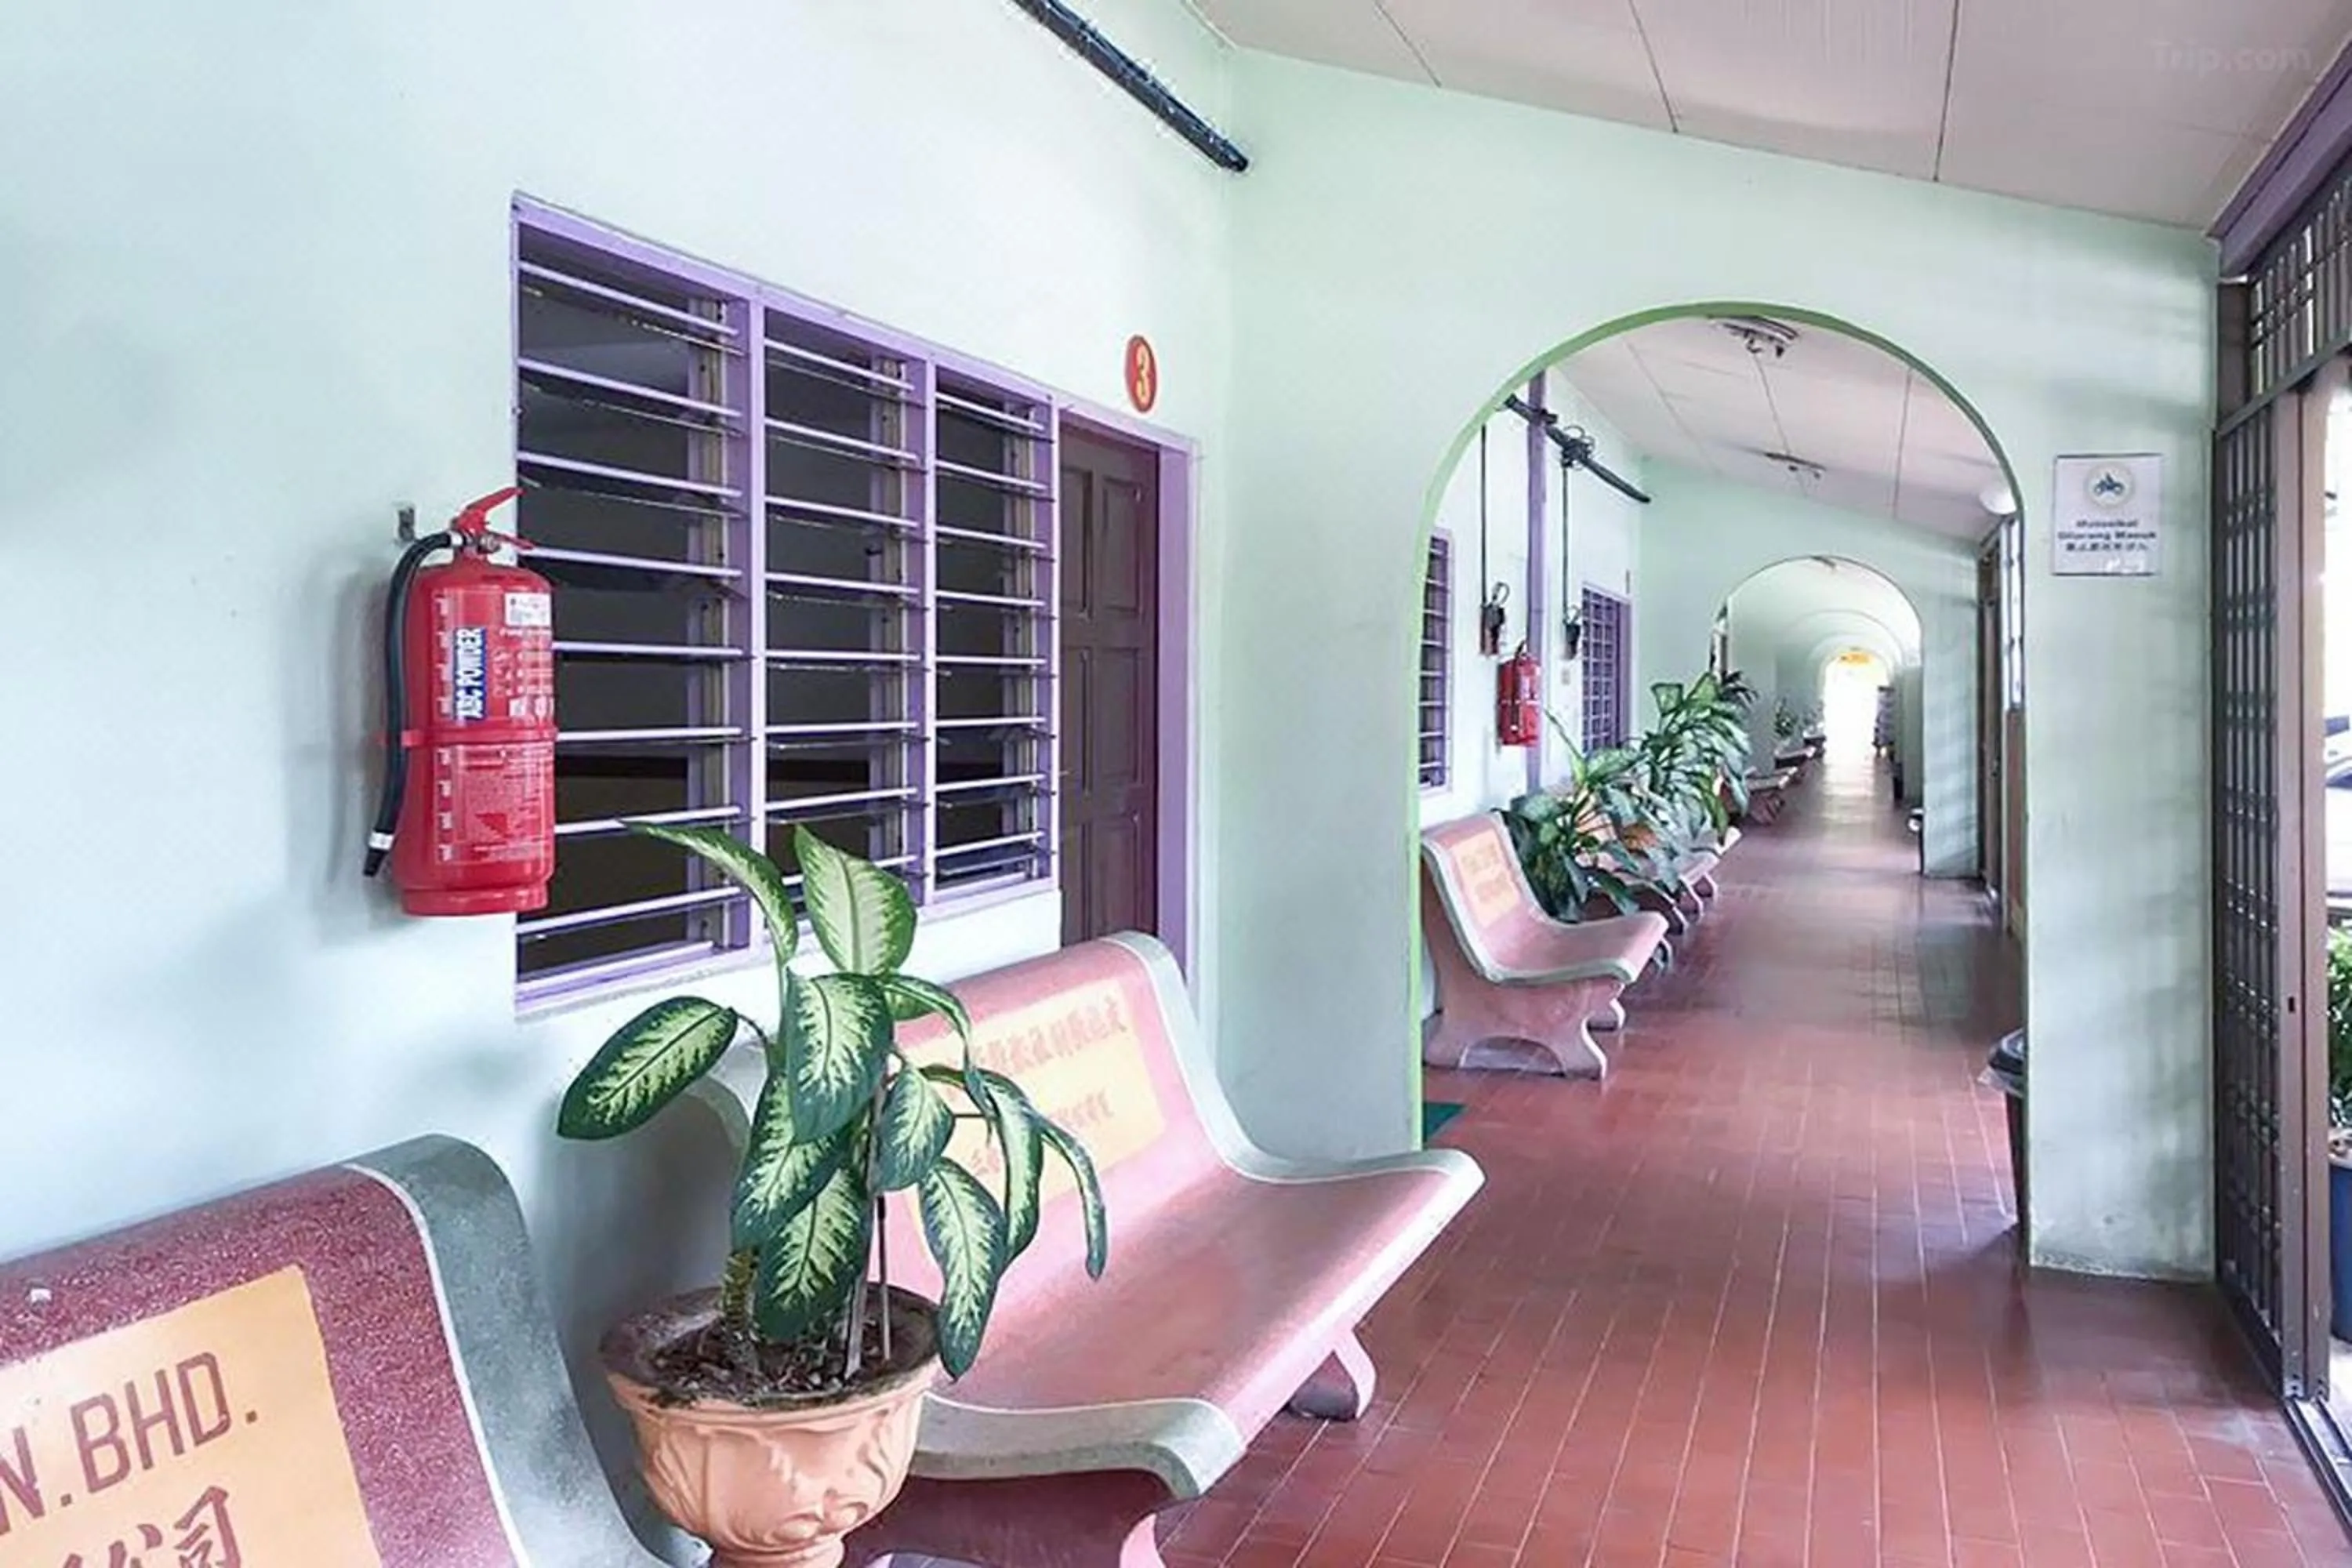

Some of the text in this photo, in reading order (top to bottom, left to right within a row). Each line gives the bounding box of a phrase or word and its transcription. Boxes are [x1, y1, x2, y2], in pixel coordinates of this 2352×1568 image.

[1136, 344, 1151, 404] 3
[456, 627, 484, 719] ABC POWDER
